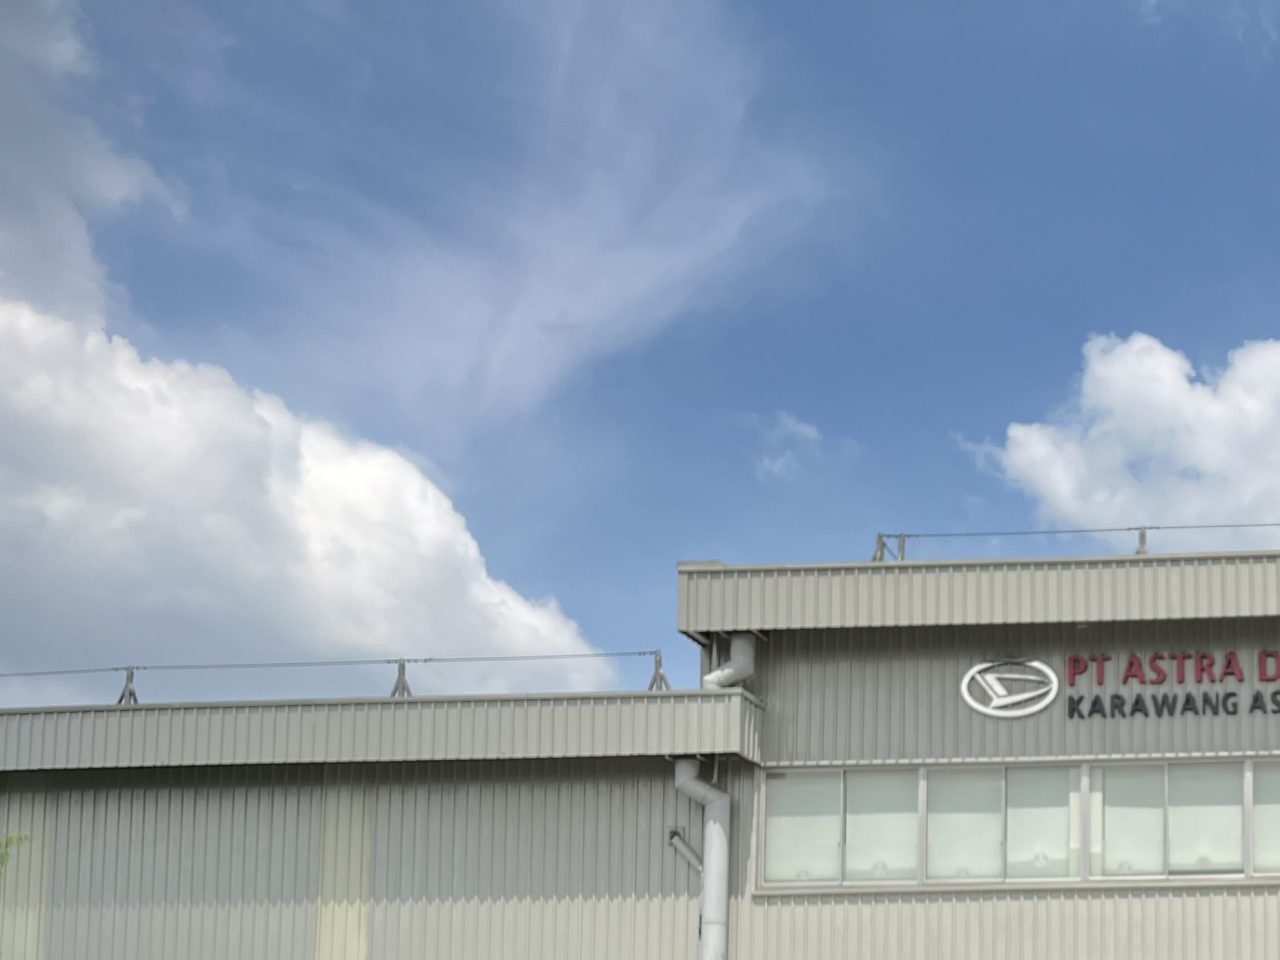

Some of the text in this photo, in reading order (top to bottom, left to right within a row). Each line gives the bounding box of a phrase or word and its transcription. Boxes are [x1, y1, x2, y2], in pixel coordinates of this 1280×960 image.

[1066, 653, 1111, 687] PT
[1121, 649, 1245, 685] ASTRA
[1066, 690, 1240, 719] KARAWANG
